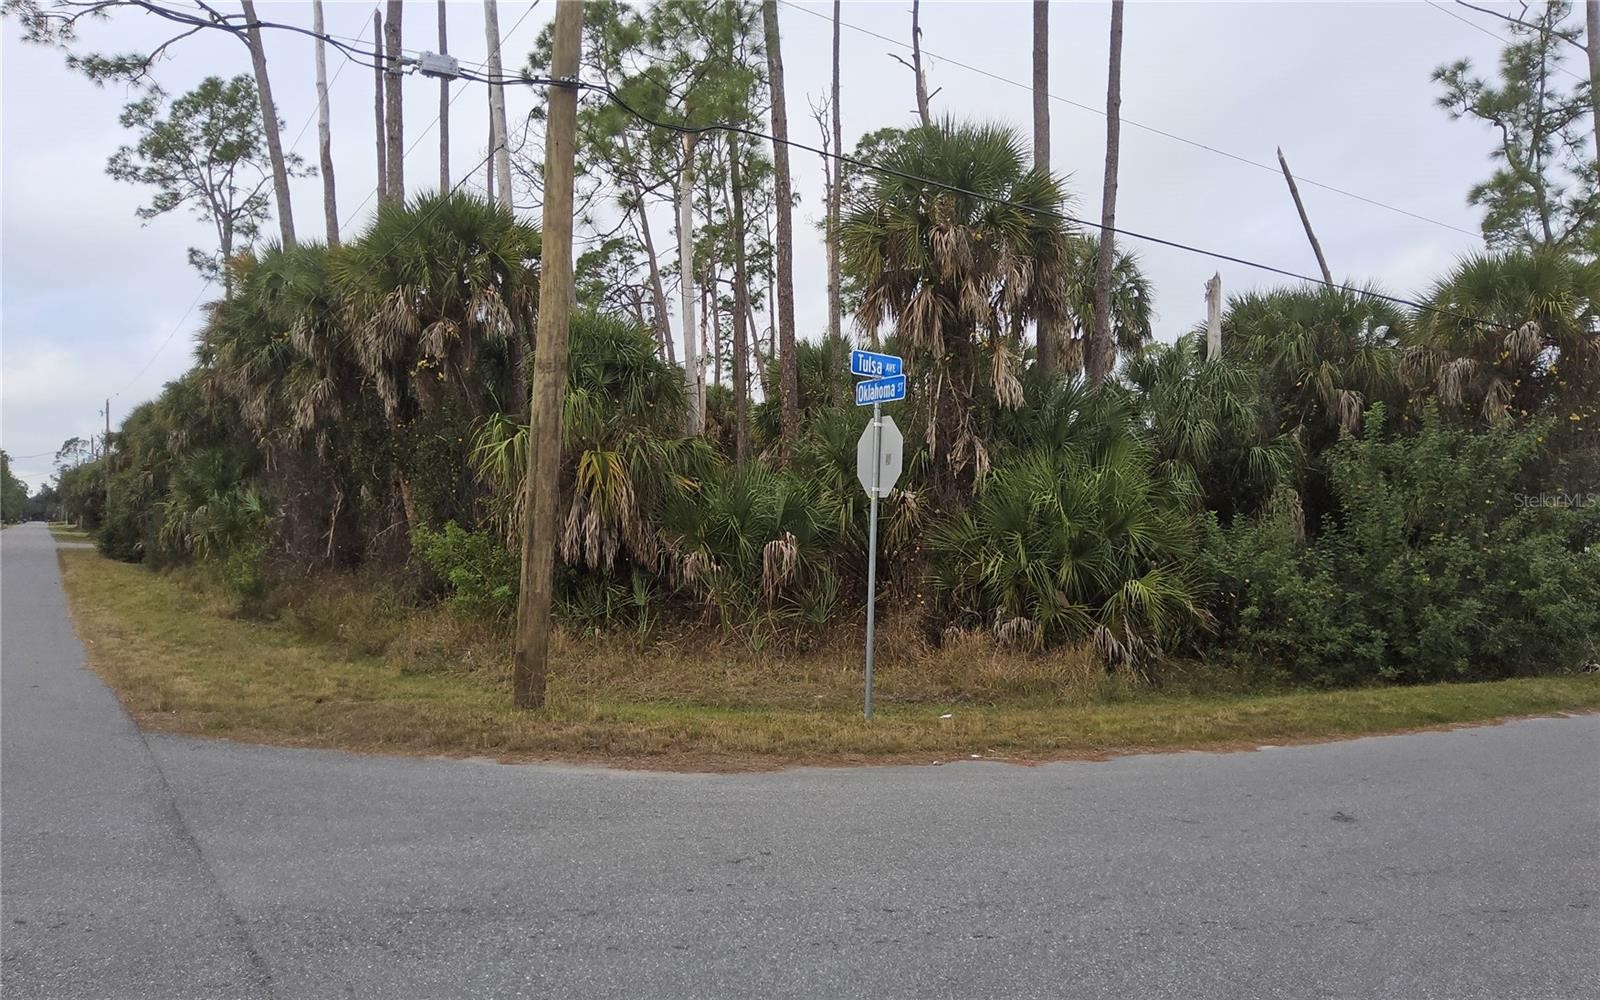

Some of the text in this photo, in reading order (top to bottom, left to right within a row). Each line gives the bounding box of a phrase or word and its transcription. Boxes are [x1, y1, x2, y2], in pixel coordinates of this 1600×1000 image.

[858, 354, 896, 375] Tulsa AVE
[858, 382, 903, 402] Oklahoma ST
